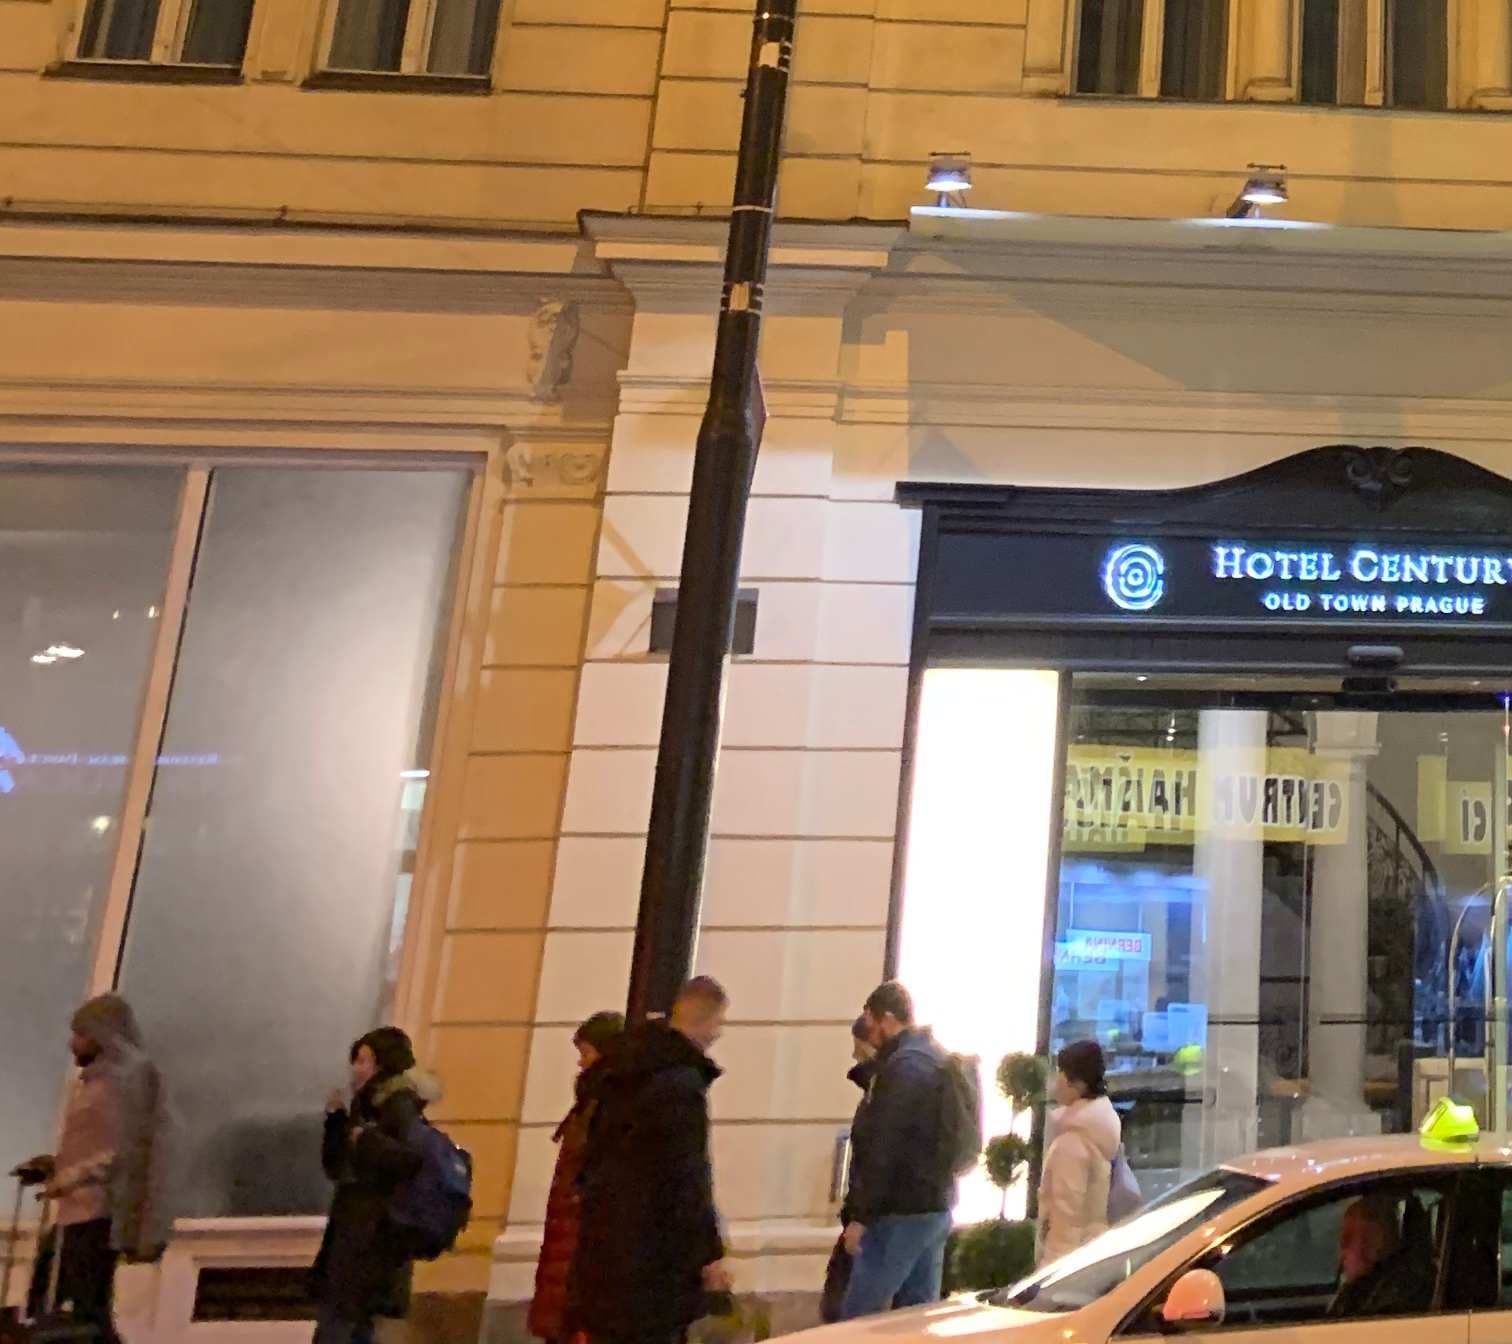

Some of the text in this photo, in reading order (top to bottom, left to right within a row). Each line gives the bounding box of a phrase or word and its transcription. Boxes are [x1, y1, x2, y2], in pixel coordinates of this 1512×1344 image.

[1213, 545, 1341, 582] HOTEL
[1263, 592, 1486, 615] OLD TOWN PRAGUE
